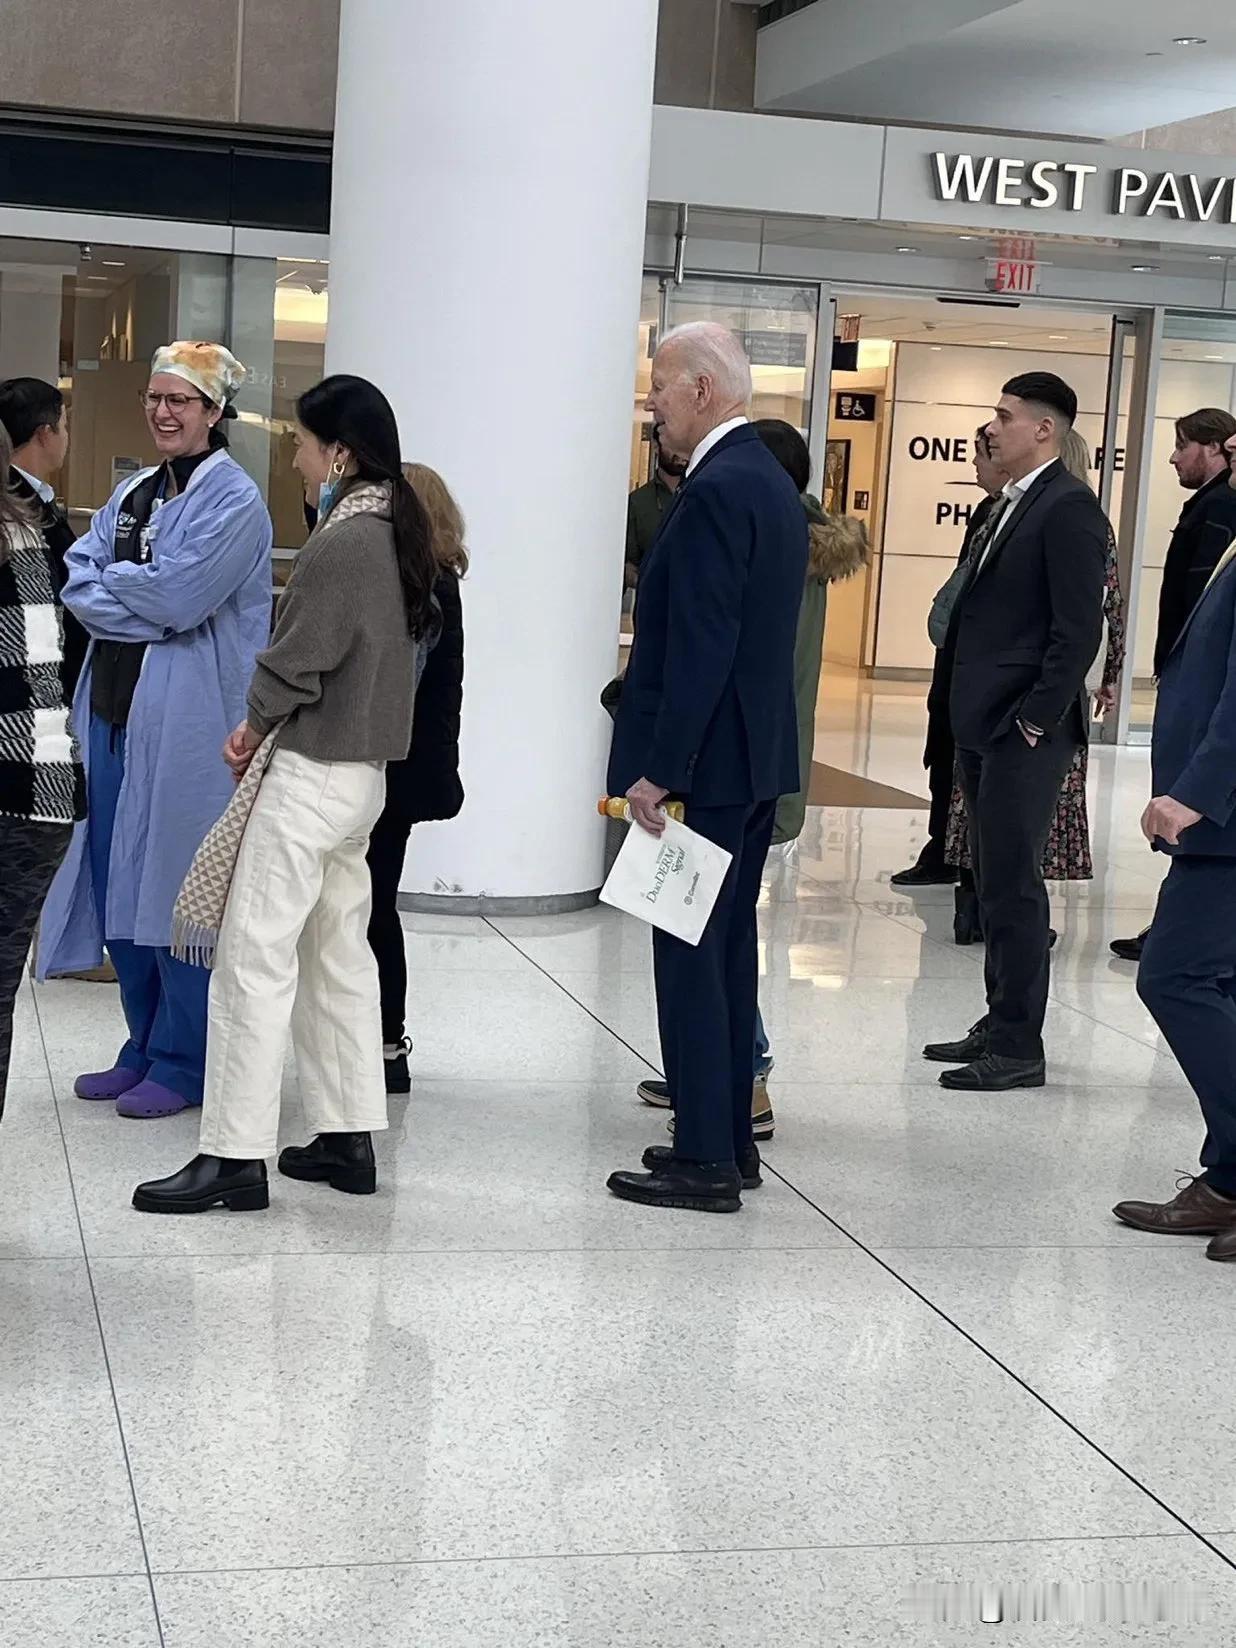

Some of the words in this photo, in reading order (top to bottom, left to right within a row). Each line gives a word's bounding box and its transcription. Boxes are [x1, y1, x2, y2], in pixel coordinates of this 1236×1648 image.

[932, 152, 1098, 212] WEST
[995, 260, 1035, 291] EXIT
[908, 436, 968, 463] ONE
